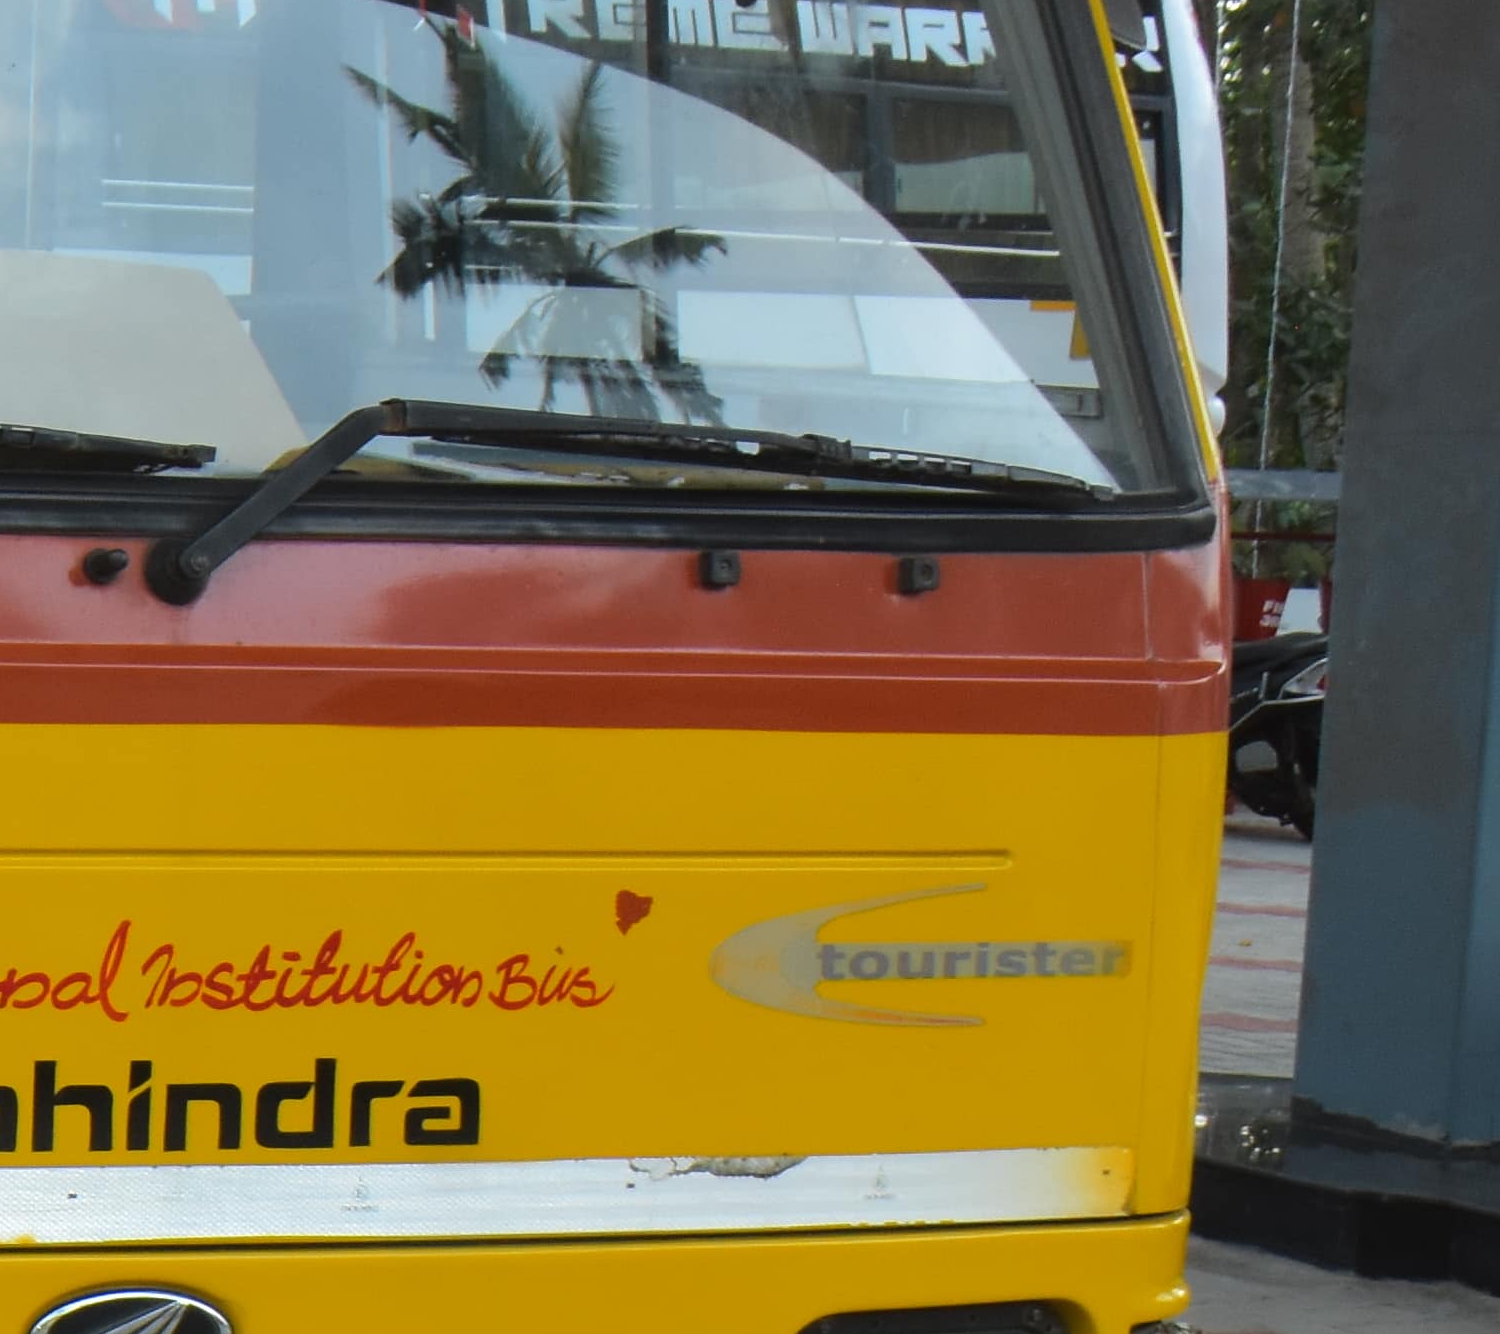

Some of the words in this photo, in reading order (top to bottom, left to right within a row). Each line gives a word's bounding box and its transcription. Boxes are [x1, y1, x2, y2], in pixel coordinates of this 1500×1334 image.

[138, 929, 492, 1012] Institution
[491, 945, 625, 1010] Bus
[816, 940, 1127, 981] tourister
